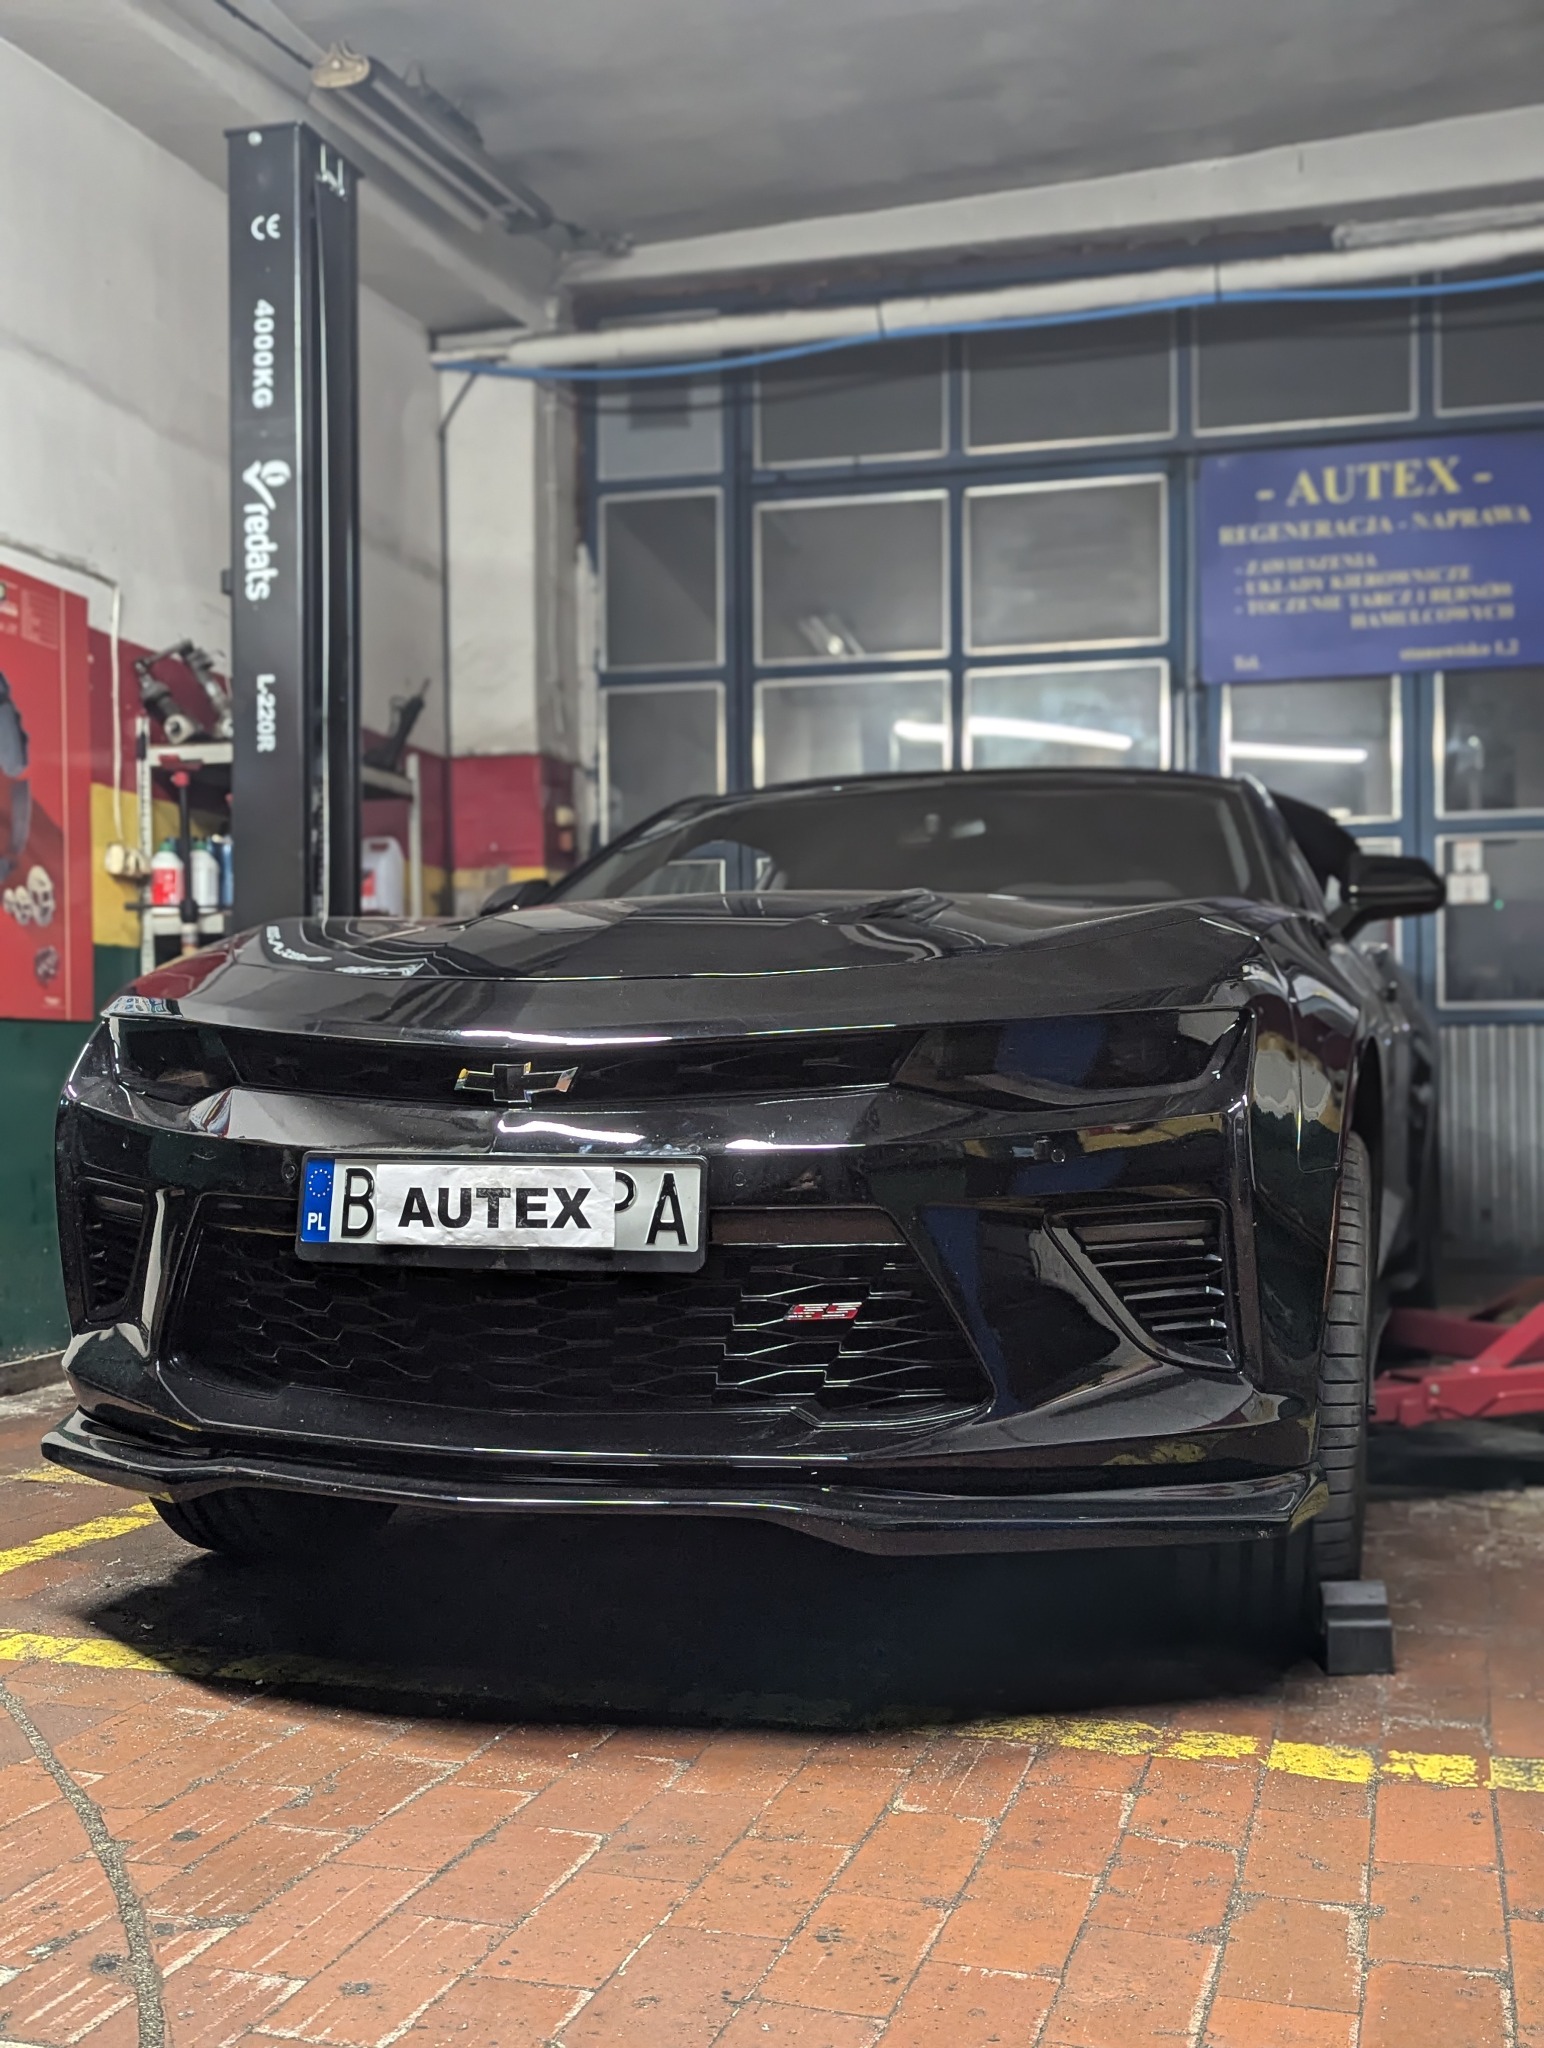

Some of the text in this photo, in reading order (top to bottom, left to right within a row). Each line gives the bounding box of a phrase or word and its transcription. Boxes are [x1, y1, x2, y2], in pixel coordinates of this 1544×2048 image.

[251, 213, 281, 241] CE
[252, 299, 275, 409] 4000KG
[1286, 456, 1462, 507] AUTEX
[1218, 516, 1394, 546] REGENERACJA
[1412, 504, 1532, 531] NAPRAWA
[243, 503, 279, 601] redats
[256, 674, 276, 753] L-220R
[306, 1212, 326, 1231] PL
[340, 1166, 376, 1239] B
[398, 1187, 592, 1229] AUTEX
[783, 1302, 862, 1320] SS
